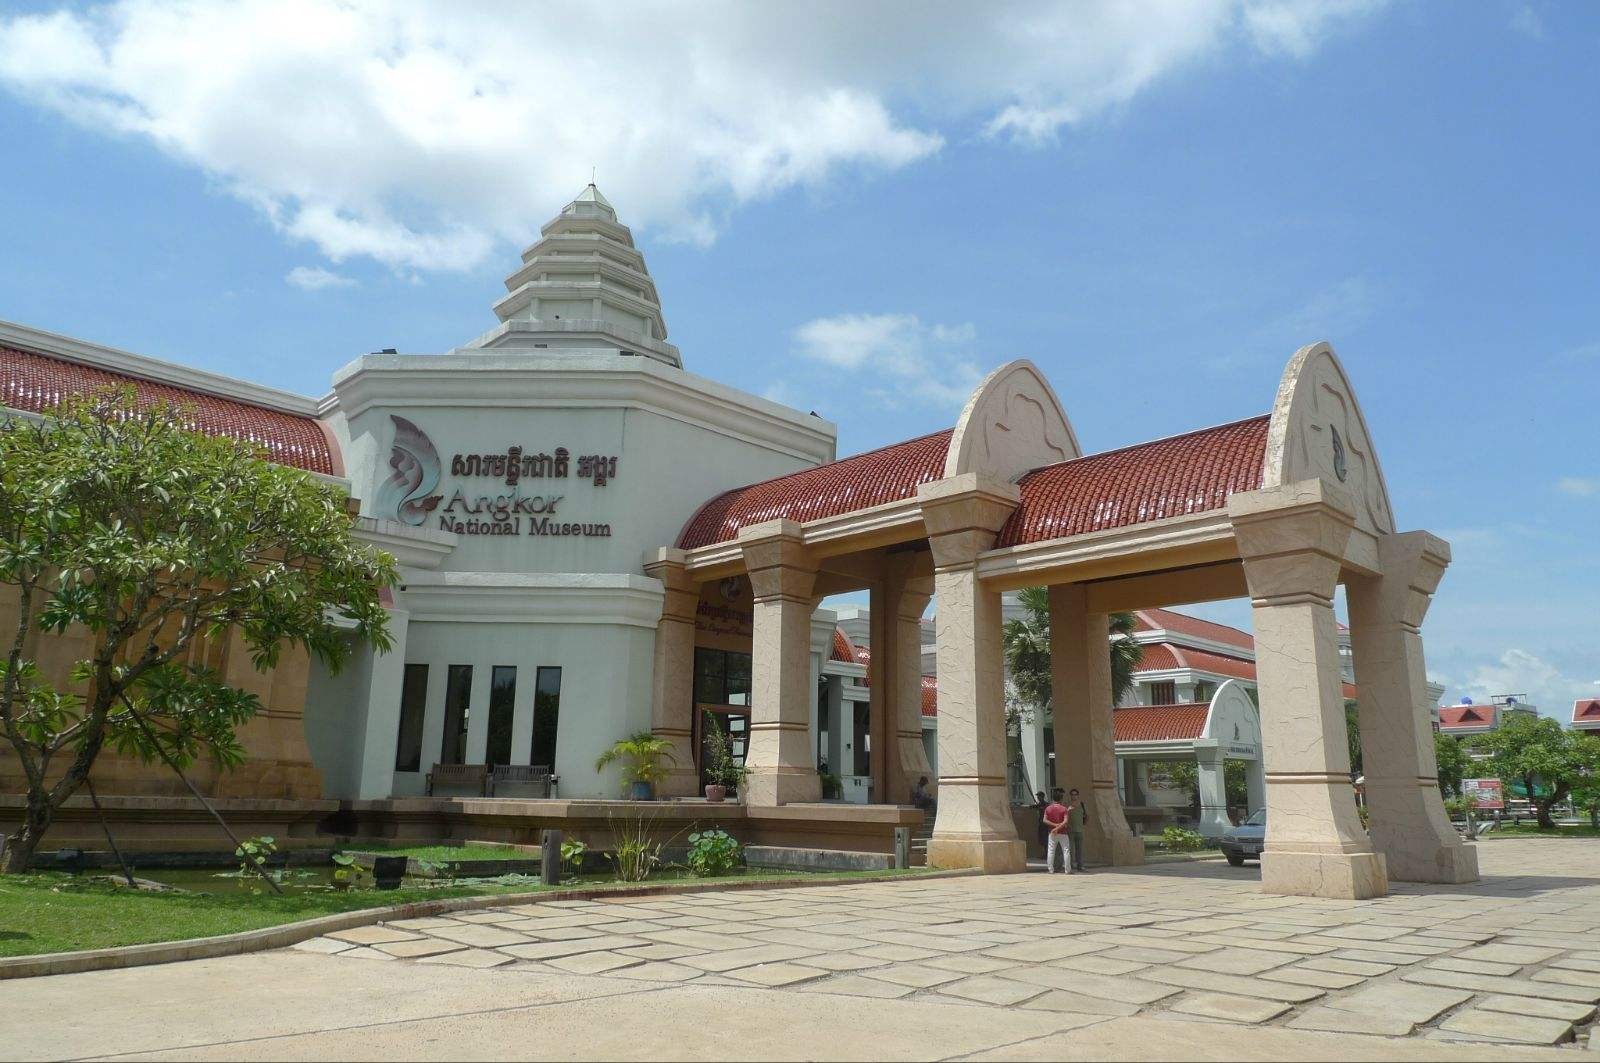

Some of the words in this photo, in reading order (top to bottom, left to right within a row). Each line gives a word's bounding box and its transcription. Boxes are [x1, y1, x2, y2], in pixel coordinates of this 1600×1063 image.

[443, 487, 565, 522] Angkor
[440, 516, 521, 536] National
[528, 518, 612, 537] Museum
